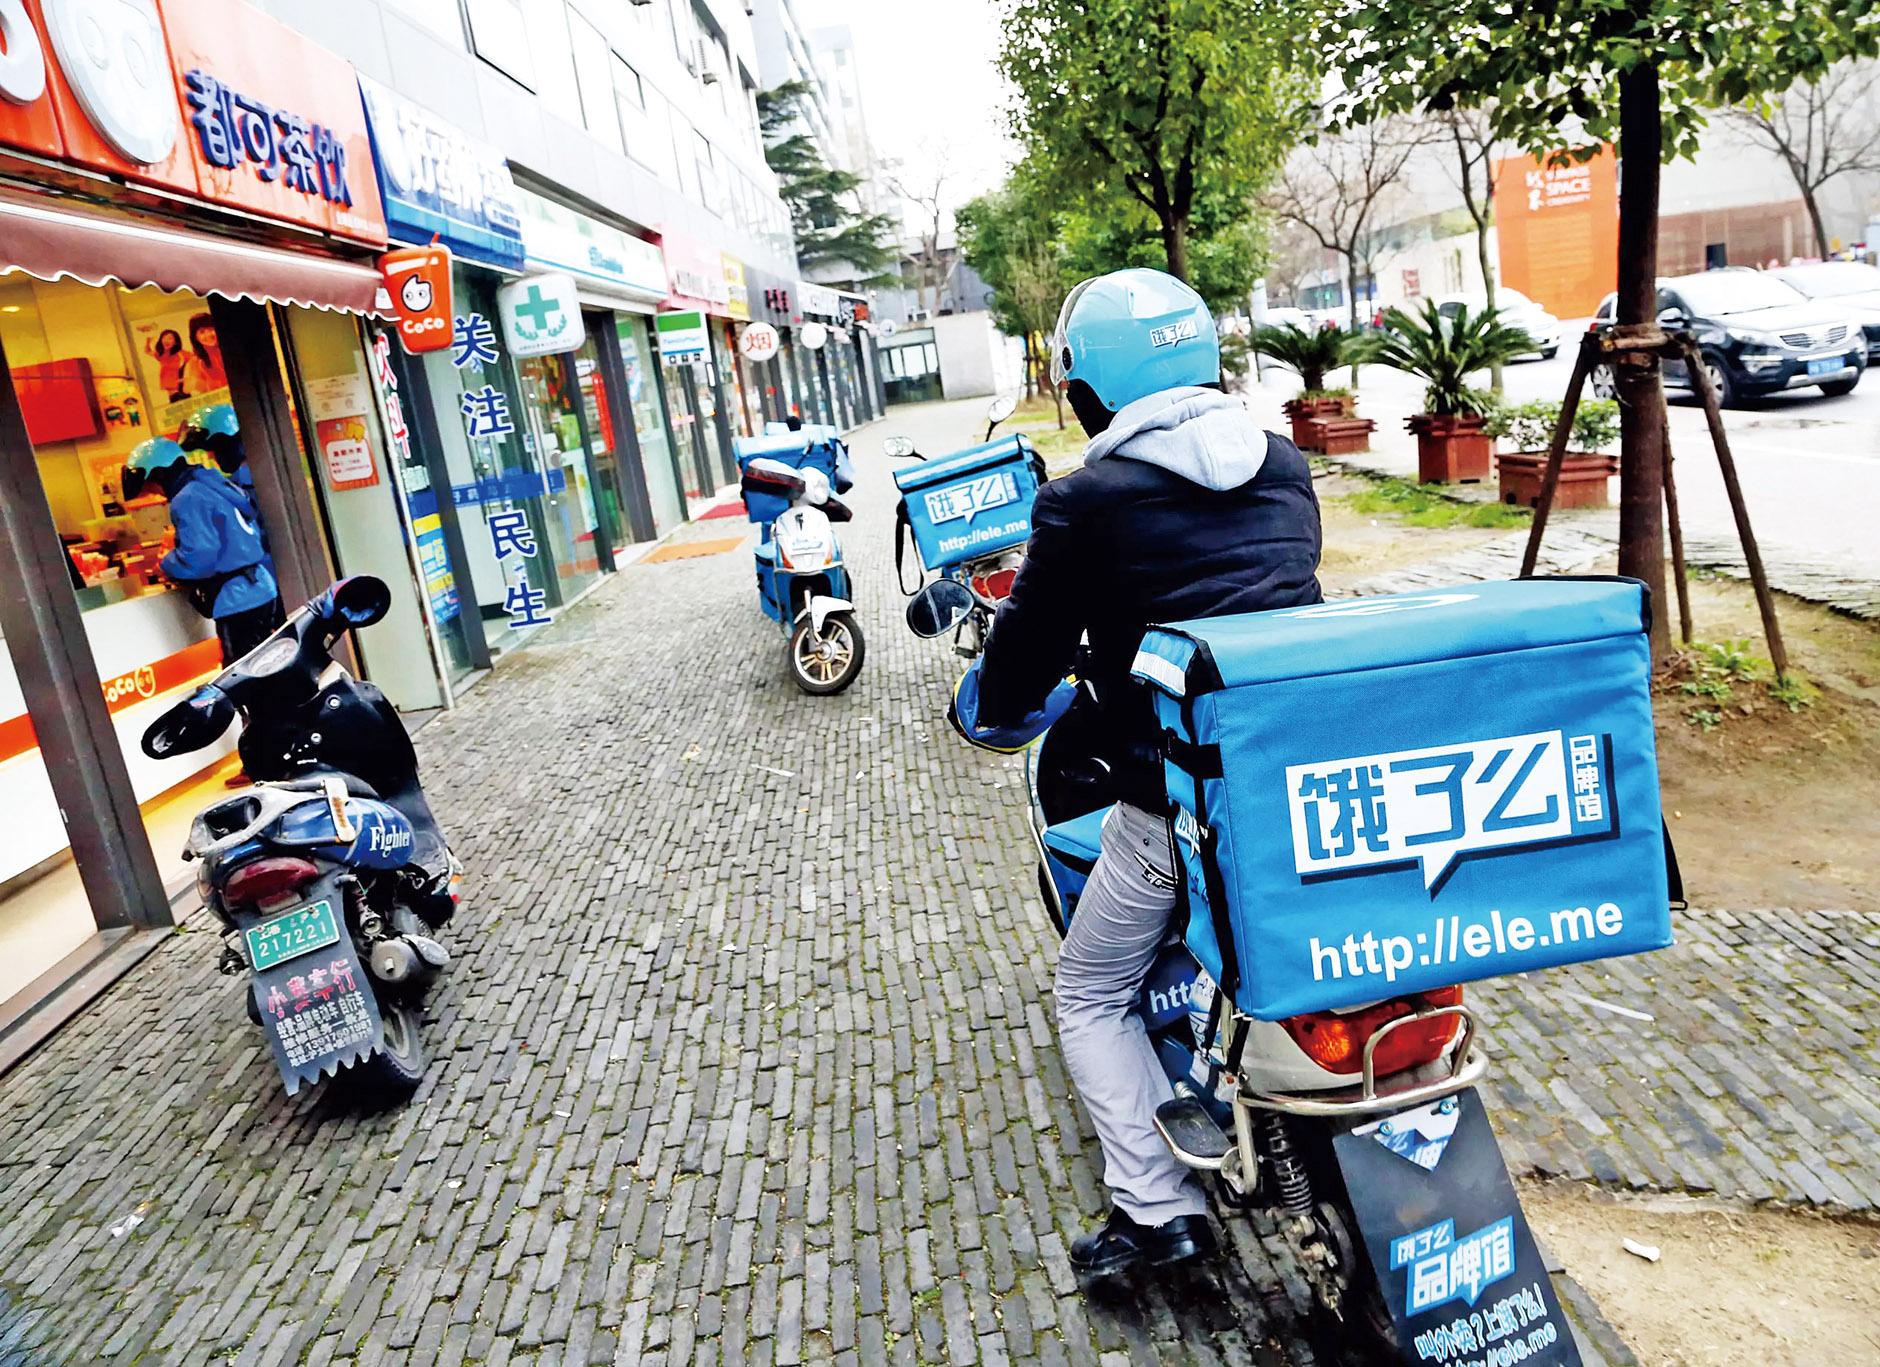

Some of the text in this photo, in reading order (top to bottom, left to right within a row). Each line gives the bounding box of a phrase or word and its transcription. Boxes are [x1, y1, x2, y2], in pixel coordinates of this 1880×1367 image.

[184, 69, 352, 208] 都可茶饮
[746, 332, 772, 353] 烟
[453, 314, 553, 628] 关注民生
[939, 519, 1028, 553] http://ele.me
[1298, 741, 1560, 861] 饿了么
[259, 921, 326, 957] 217221
[1309, 902, 1623, 982] http://ele.me
[1149, 981, 1194, 1014] htt
